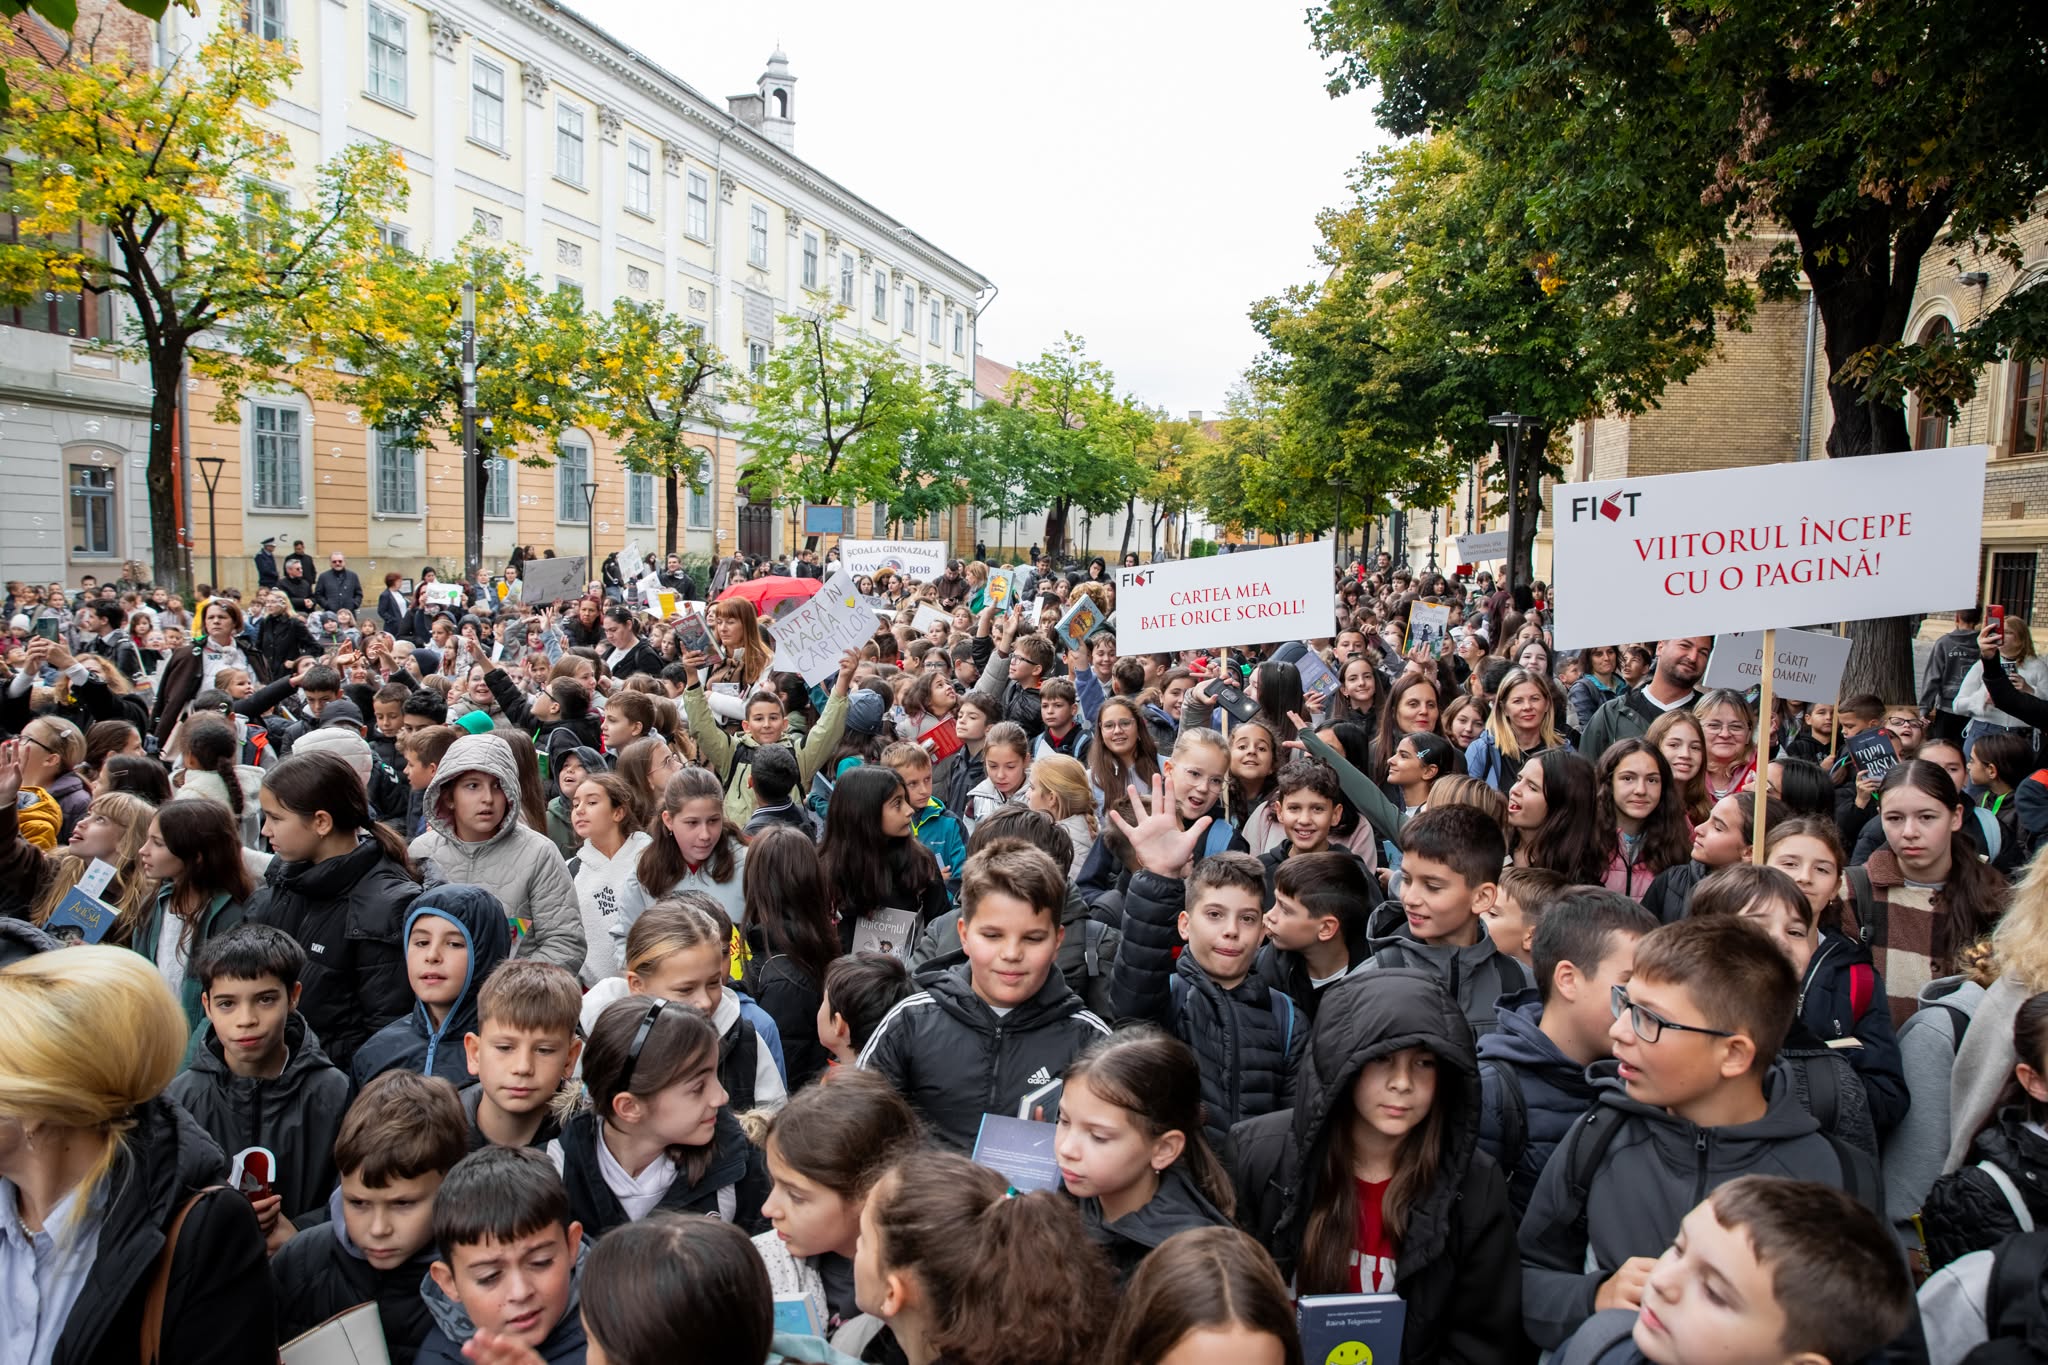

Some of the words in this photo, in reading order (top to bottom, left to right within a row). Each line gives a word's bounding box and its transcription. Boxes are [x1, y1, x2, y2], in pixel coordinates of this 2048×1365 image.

[1633, 524, 1789, 562] VIITORUL
[1799, 512, 1912, 547] ÎNCEPE
[909, 566, 931, 575] BOB
[1663, 569, 1709, 597] CU
[1719, 566, 1744, 591] O
[1756, 549, 1881, 588] PAGINĂ!
[1170, 587, 1231, 606] CARTEA
[1236, 582, 1271, 598] MEA
[1141, 613, 1177, 630] BATE
[1181, 607, 1230, 626] ORICE
[1237, 600, 1305, 621] SCROLL!
[1738, 662, 1762, 676] CRES
[1772, 668, 1817, 685] OAMENI!
[593, 891, 616, 902] what
[598, 900, 614, 910] you
